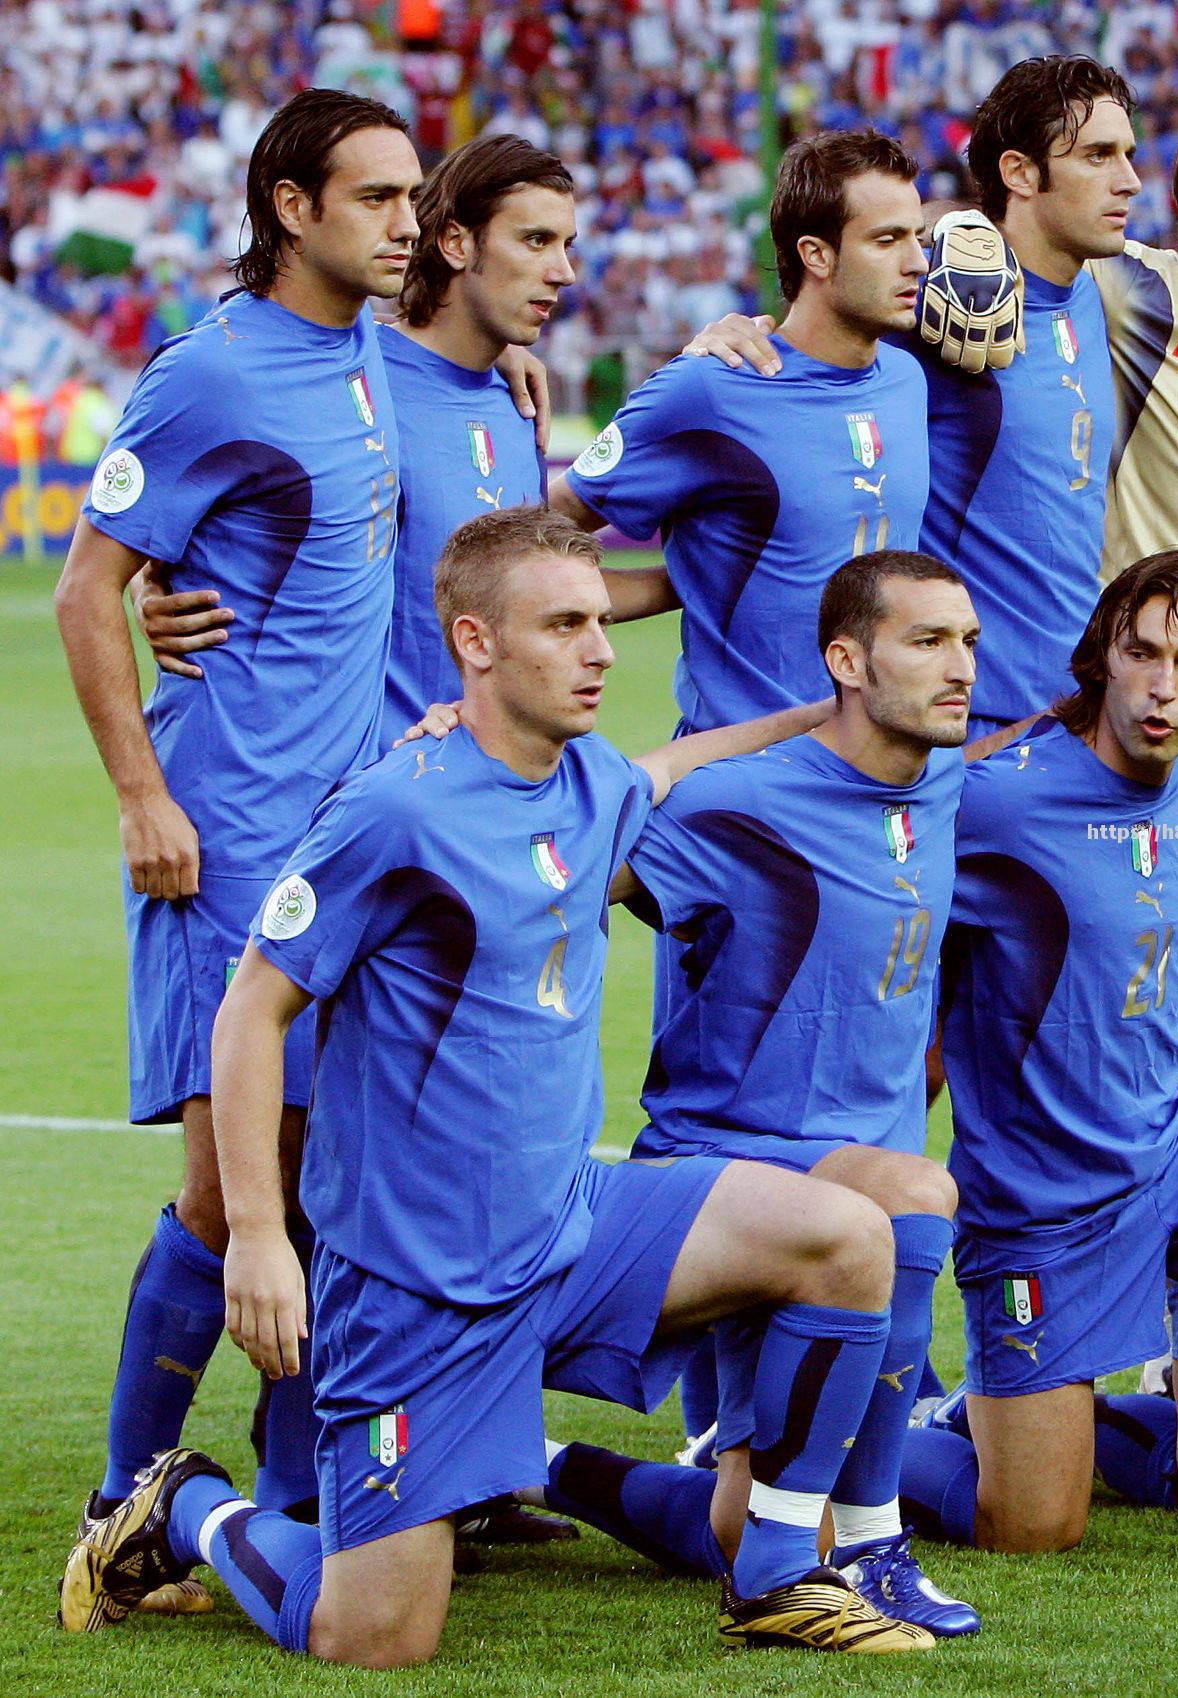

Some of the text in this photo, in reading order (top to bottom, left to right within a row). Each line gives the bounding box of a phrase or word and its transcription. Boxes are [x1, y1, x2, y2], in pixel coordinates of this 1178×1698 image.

[847, 413, 873, 422] ITALIA
[1070, 410, 1092, 491] 9
[532, 834, 552, 844] ITALIA
[884, 806, 908, 816] ITALIA
[537, 935, 575, 1020] 4
[878, 908, 930, 1001] 19
[1121, 924, 1173, 1019] 21
